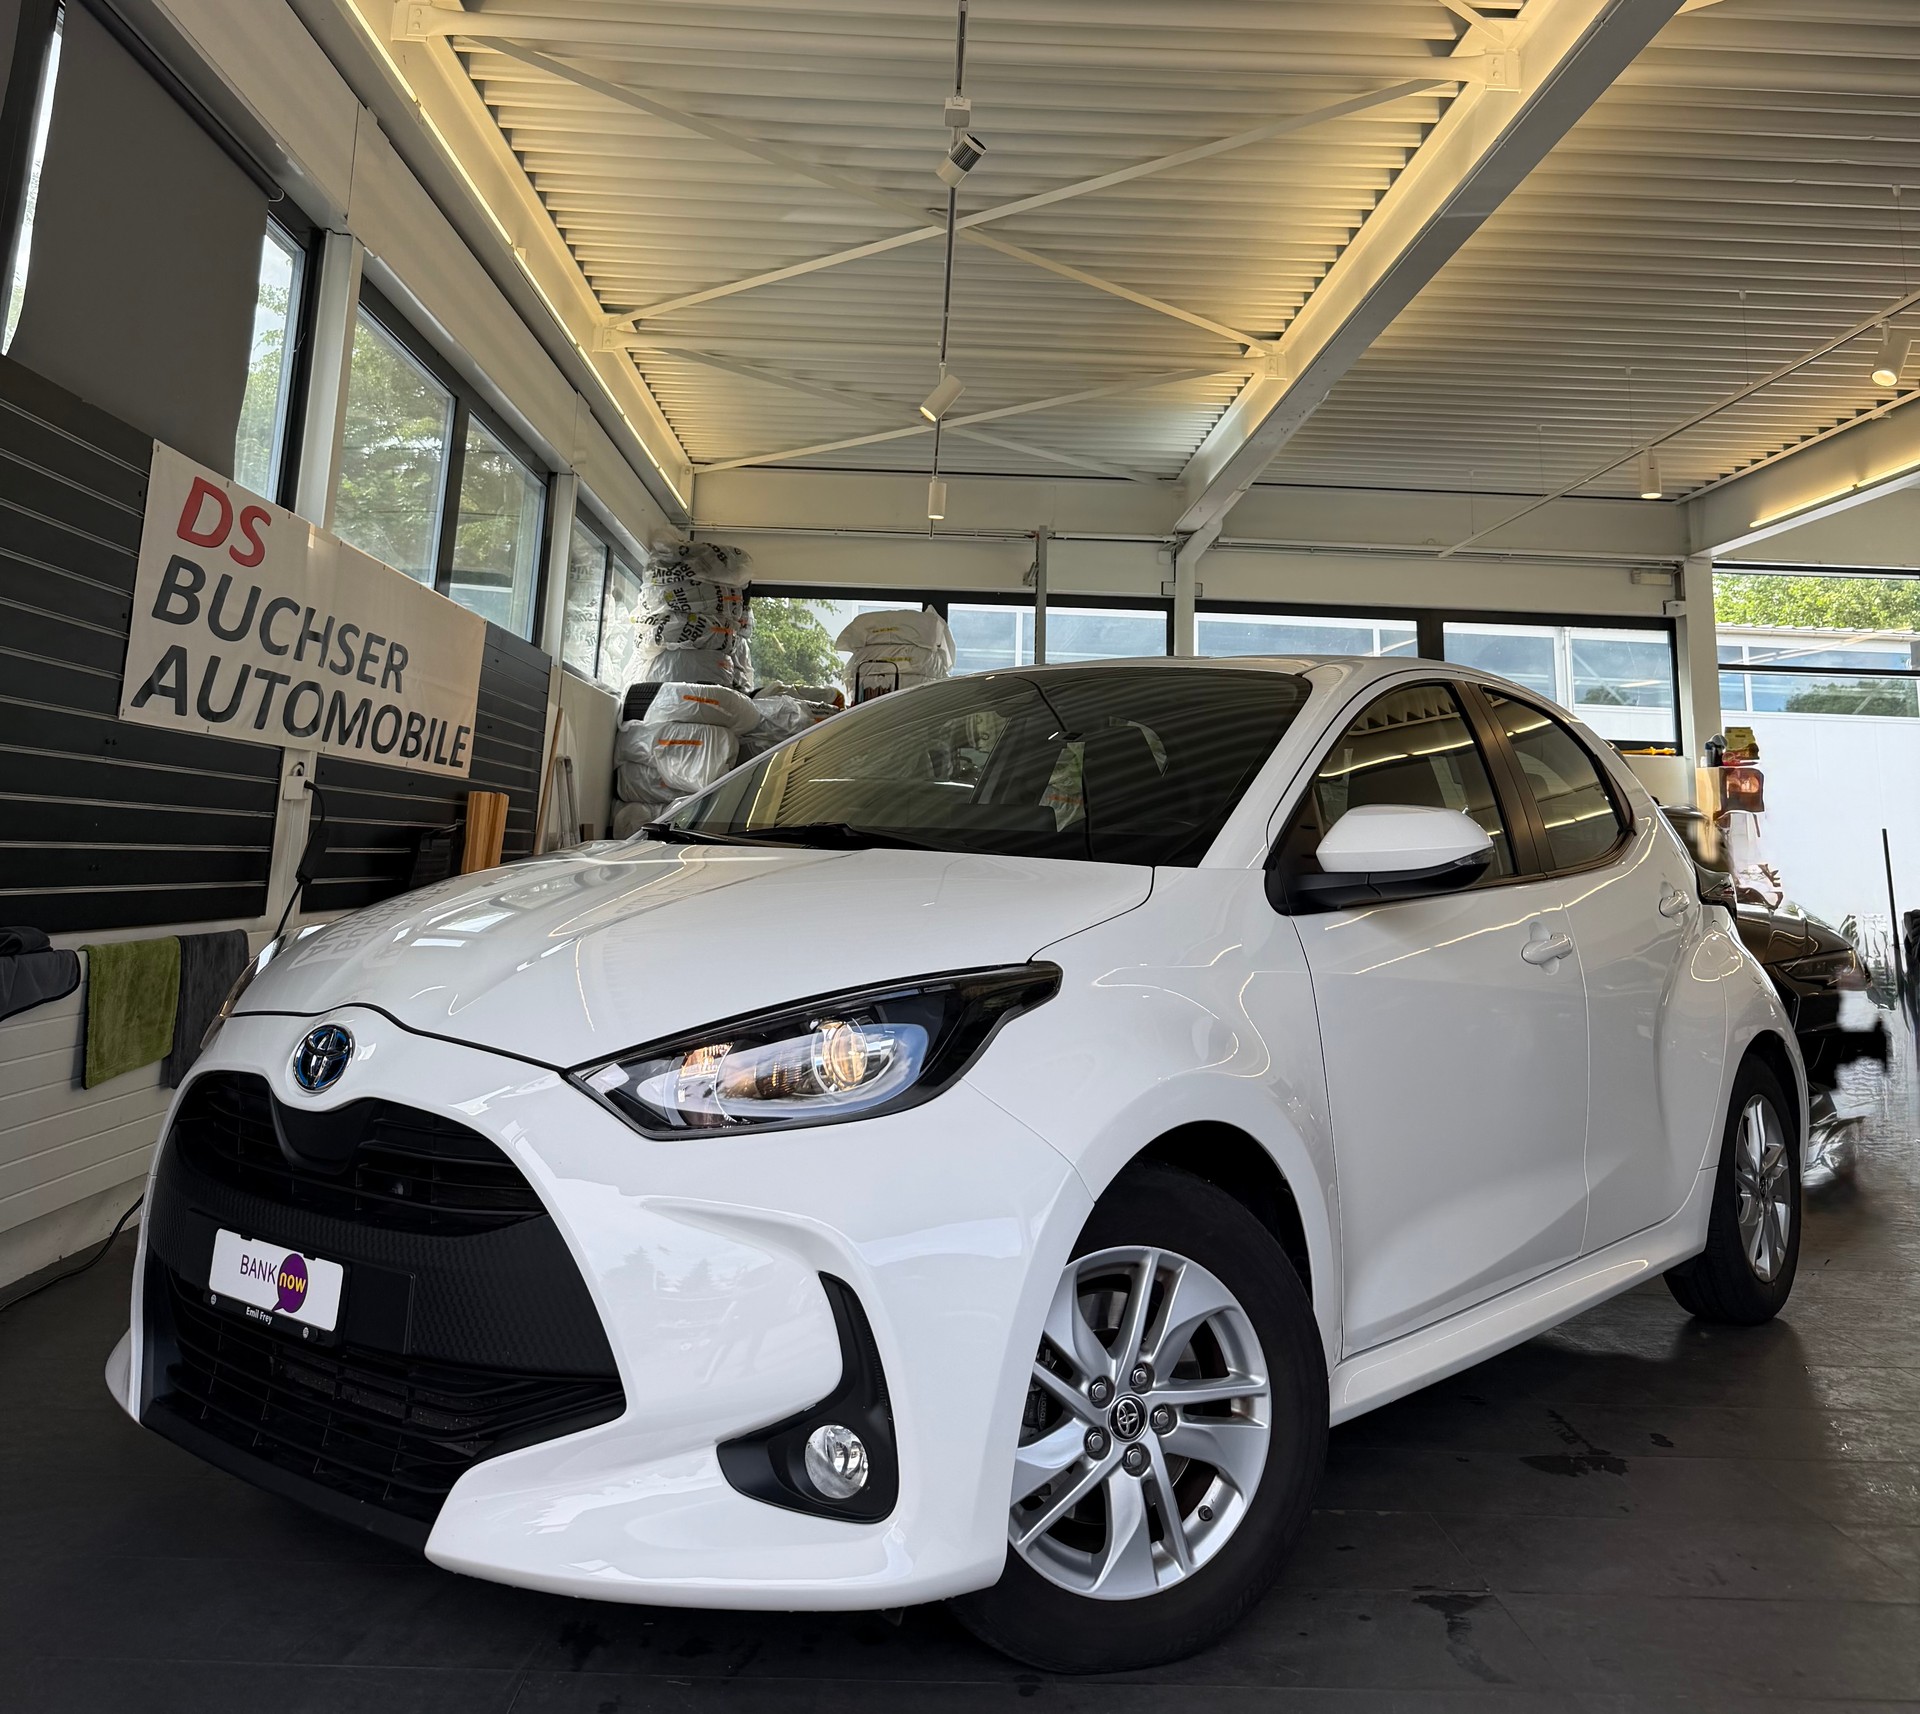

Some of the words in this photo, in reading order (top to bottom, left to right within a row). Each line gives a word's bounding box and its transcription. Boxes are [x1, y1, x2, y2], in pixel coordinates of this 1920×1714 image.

[176, 476, 272, 567] DS
[151, 554, 409, 694] BUCHSER
[130, 644, 471, 768] AUTOMOBILE
[240, 1254, 278, 1285] BANK
[279, 1272, 306, 1293] now
[246, 1306, 259, 1319] Emil
[260, 1310, 273, 1325] Frey
